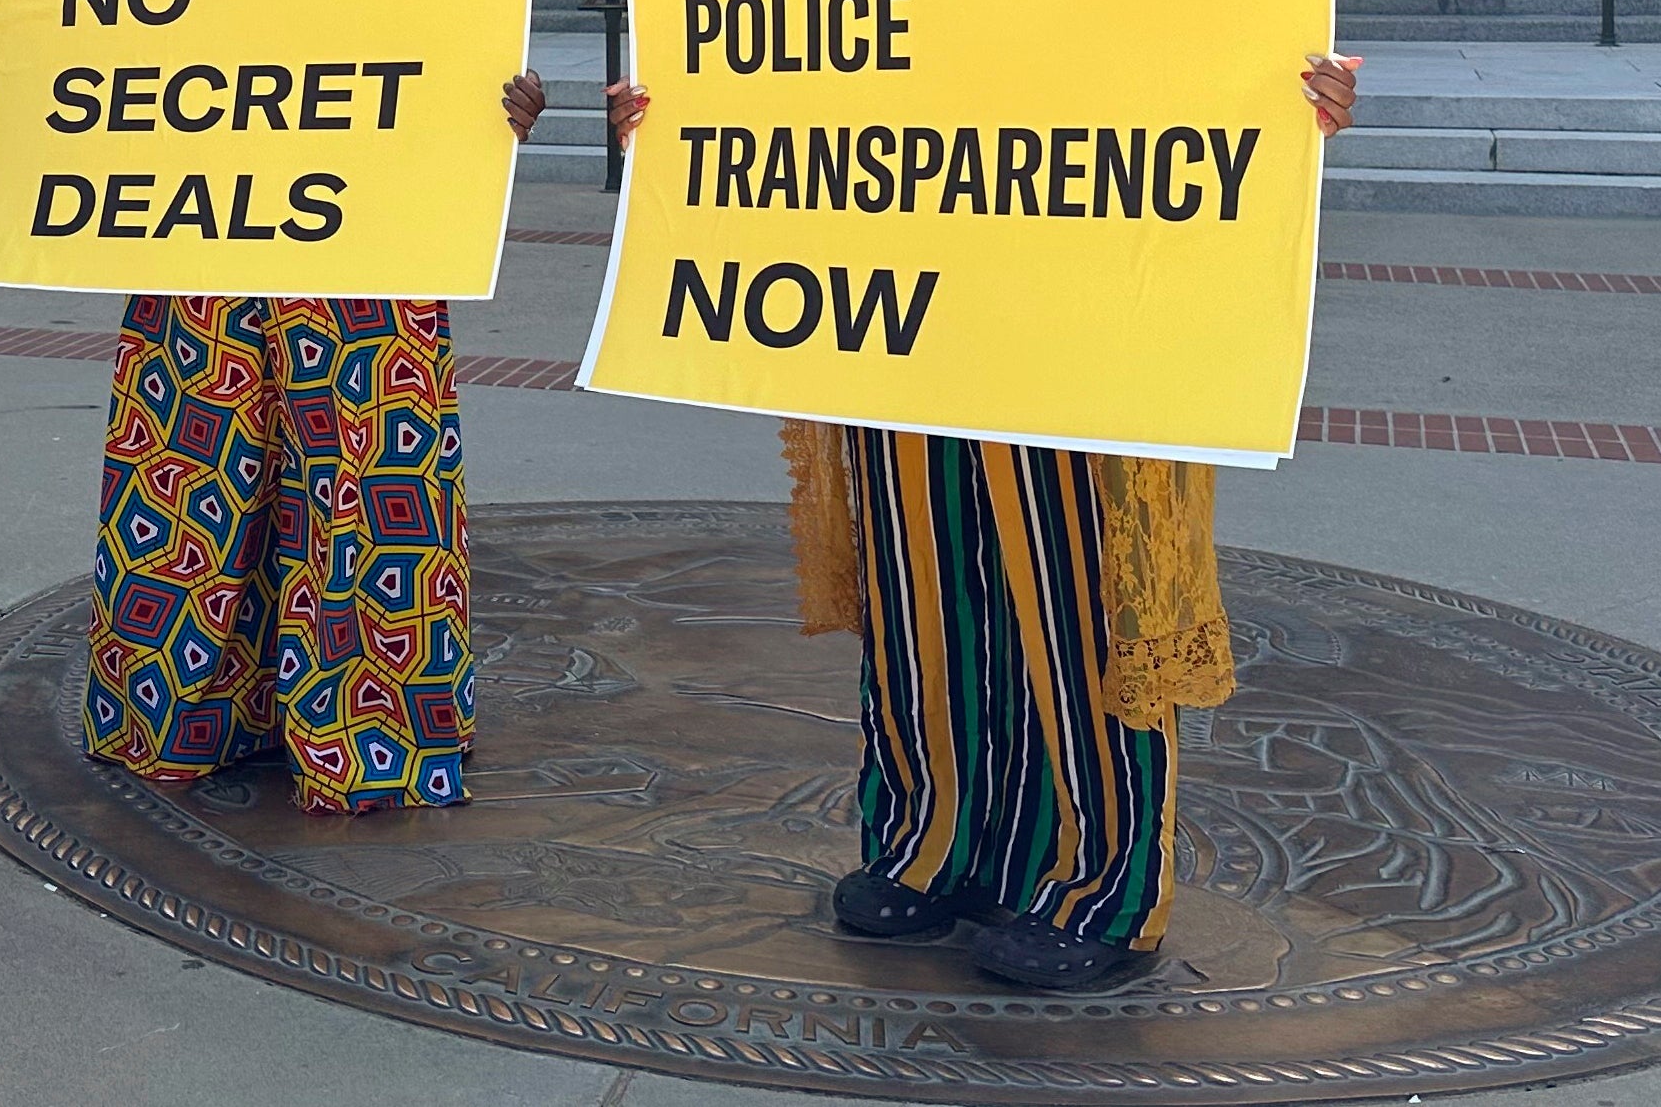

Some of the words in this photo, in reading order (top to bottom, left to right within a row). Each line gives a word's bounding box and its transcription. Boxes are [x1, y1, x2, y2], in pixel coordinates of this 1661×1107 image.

[45, 61, 424, 134] SECRET
[30, 172, 348, 243] DEALS
[679, 125, 1262, 222] TRANSPARENCY
[661, 258, 941, 356] NOW
[410, 947, 970, 1053] CALIFORNIA
